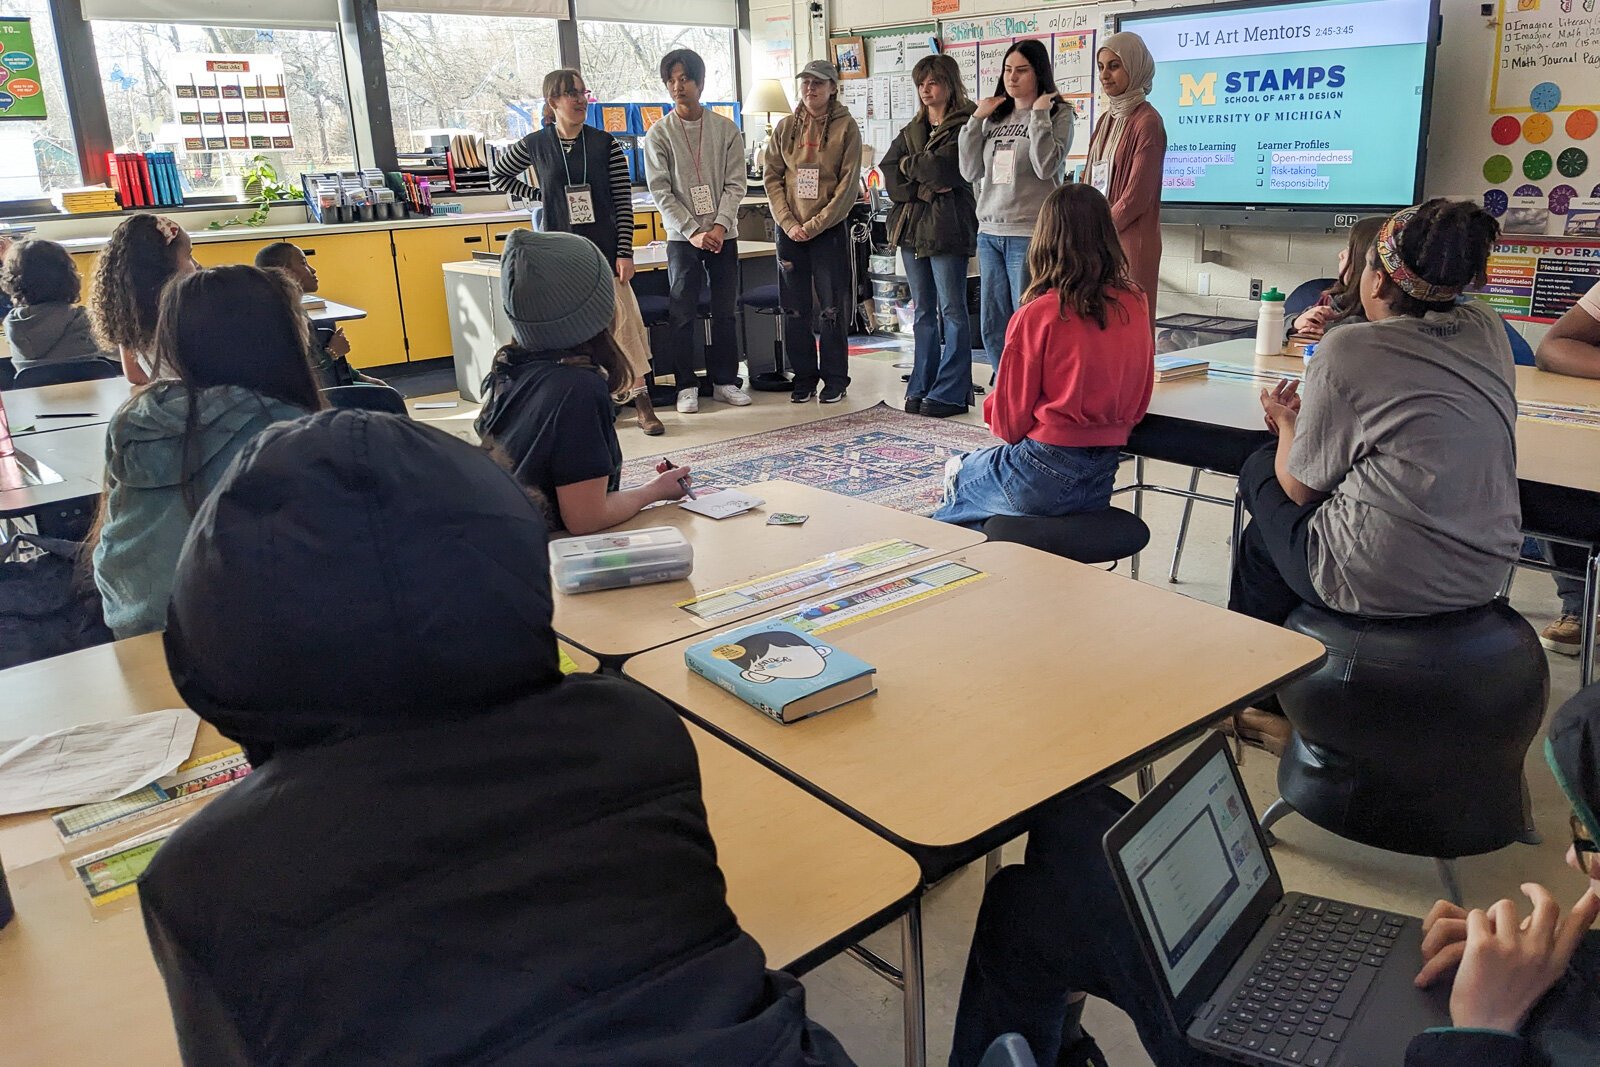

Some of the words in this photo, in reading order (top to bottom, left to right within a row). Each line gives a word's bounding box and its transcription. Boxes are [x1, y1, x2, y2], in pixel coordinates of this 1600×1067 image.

[1006, 13, 1037, 36] Planet
[1049, 11, 1088, 30] 02/07/24
[1514, 20, 1553, 33] Imagine
[1177, 30, 1211, 48] U-M
[1214, 29, 1239, 45] Art
[1243, 24, 1311, 42] Mentors
[1315, 25, 1354, 37] 2:45-3:45
[1514, 33, 1552, 43] Imagine
[1511, 57, 1536, 69] Math
[1539, 52, 1577, 66] Journal
[1178, 72, 1218, 107] M
[1225, 65, 1346, 94] STAMPS
[1225, 95, 1260, 104] SCHOOL
[1263, 94, 1275, 102] OF
[1278, 93, 1296, 101] ART
[1308, 91, 1344, 100] DESIGN
[1178, 113, 1251, 124] UNIVERSITY
[1255, 112, 1270, 121] OF
[1275, 110, 1342, 121] MICHIGAN
[987, 124, 1030, 139] MICHIGA
[1167, 143, 1188, 151] ches
[1199, 142, 1237, 152] Learning
[1257, 141, 1293, 150] Learner
[1294, 140, 1330, 149] Profiles
[1214, 154, 1234, 163] Skills
[1271, 153, 1352, 164] Open-mindedness
[1165, 167, 1185, 177] nking
[1186, 166, 1206, 175] Skills
[1271, 166, 1317, 177] Risk-taking
[1163, 178, 1175, 187] cial
[1176, 178, 1195, 187] Skills
[1270, 178, 1330, 190] Responsibility
[571, 201, 591, 213] Eva
[1493, 244, 1528, 254] RDER
[1532, 247, 1550, 255] OF
[1554, 247, 1600, 258] OPERA
[1491, 278, 1532, 286] Multiplication
